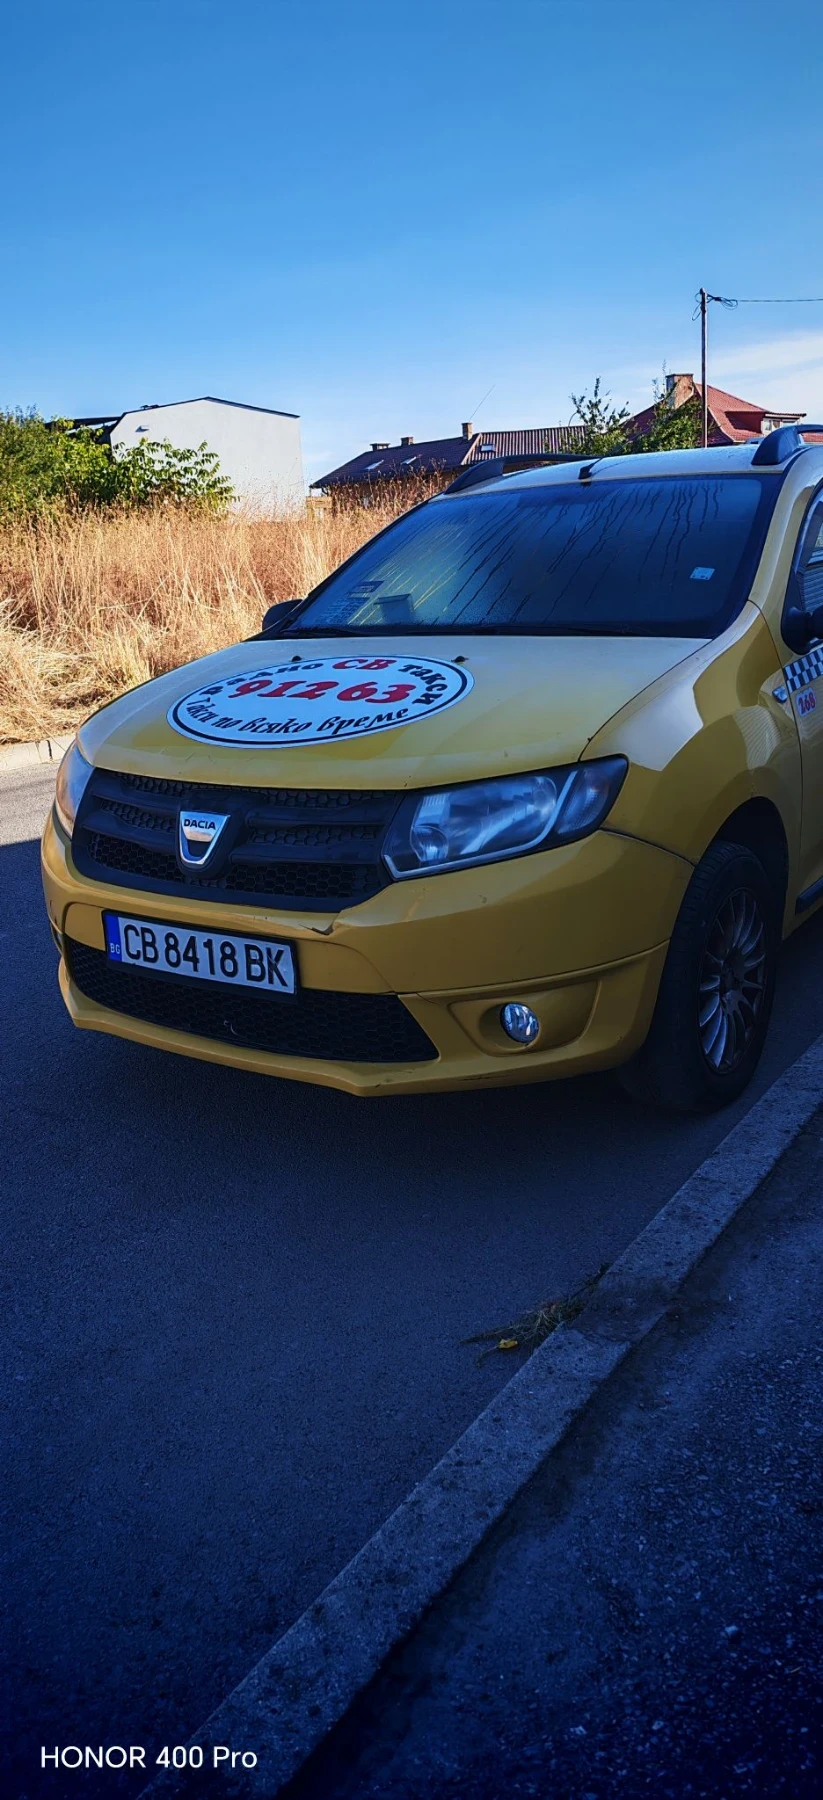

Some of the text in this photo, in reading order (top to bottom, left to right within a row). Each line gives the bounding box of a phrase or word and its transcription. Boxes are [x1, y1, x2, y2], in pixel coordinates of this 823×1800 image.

[228, 680, 417, 703] 912 63
[398, 664, 448, 705] такси
[799, 692, 816, 714] 268
[211, 717, 243, 728] по
[238, 717, 312, 733] всяко
[316, 708, 409, 734] време
[183, 818, 216, 830] DACIA
[110, 942, 121, 954] BG
[164, 932, 239, 978] 8418
